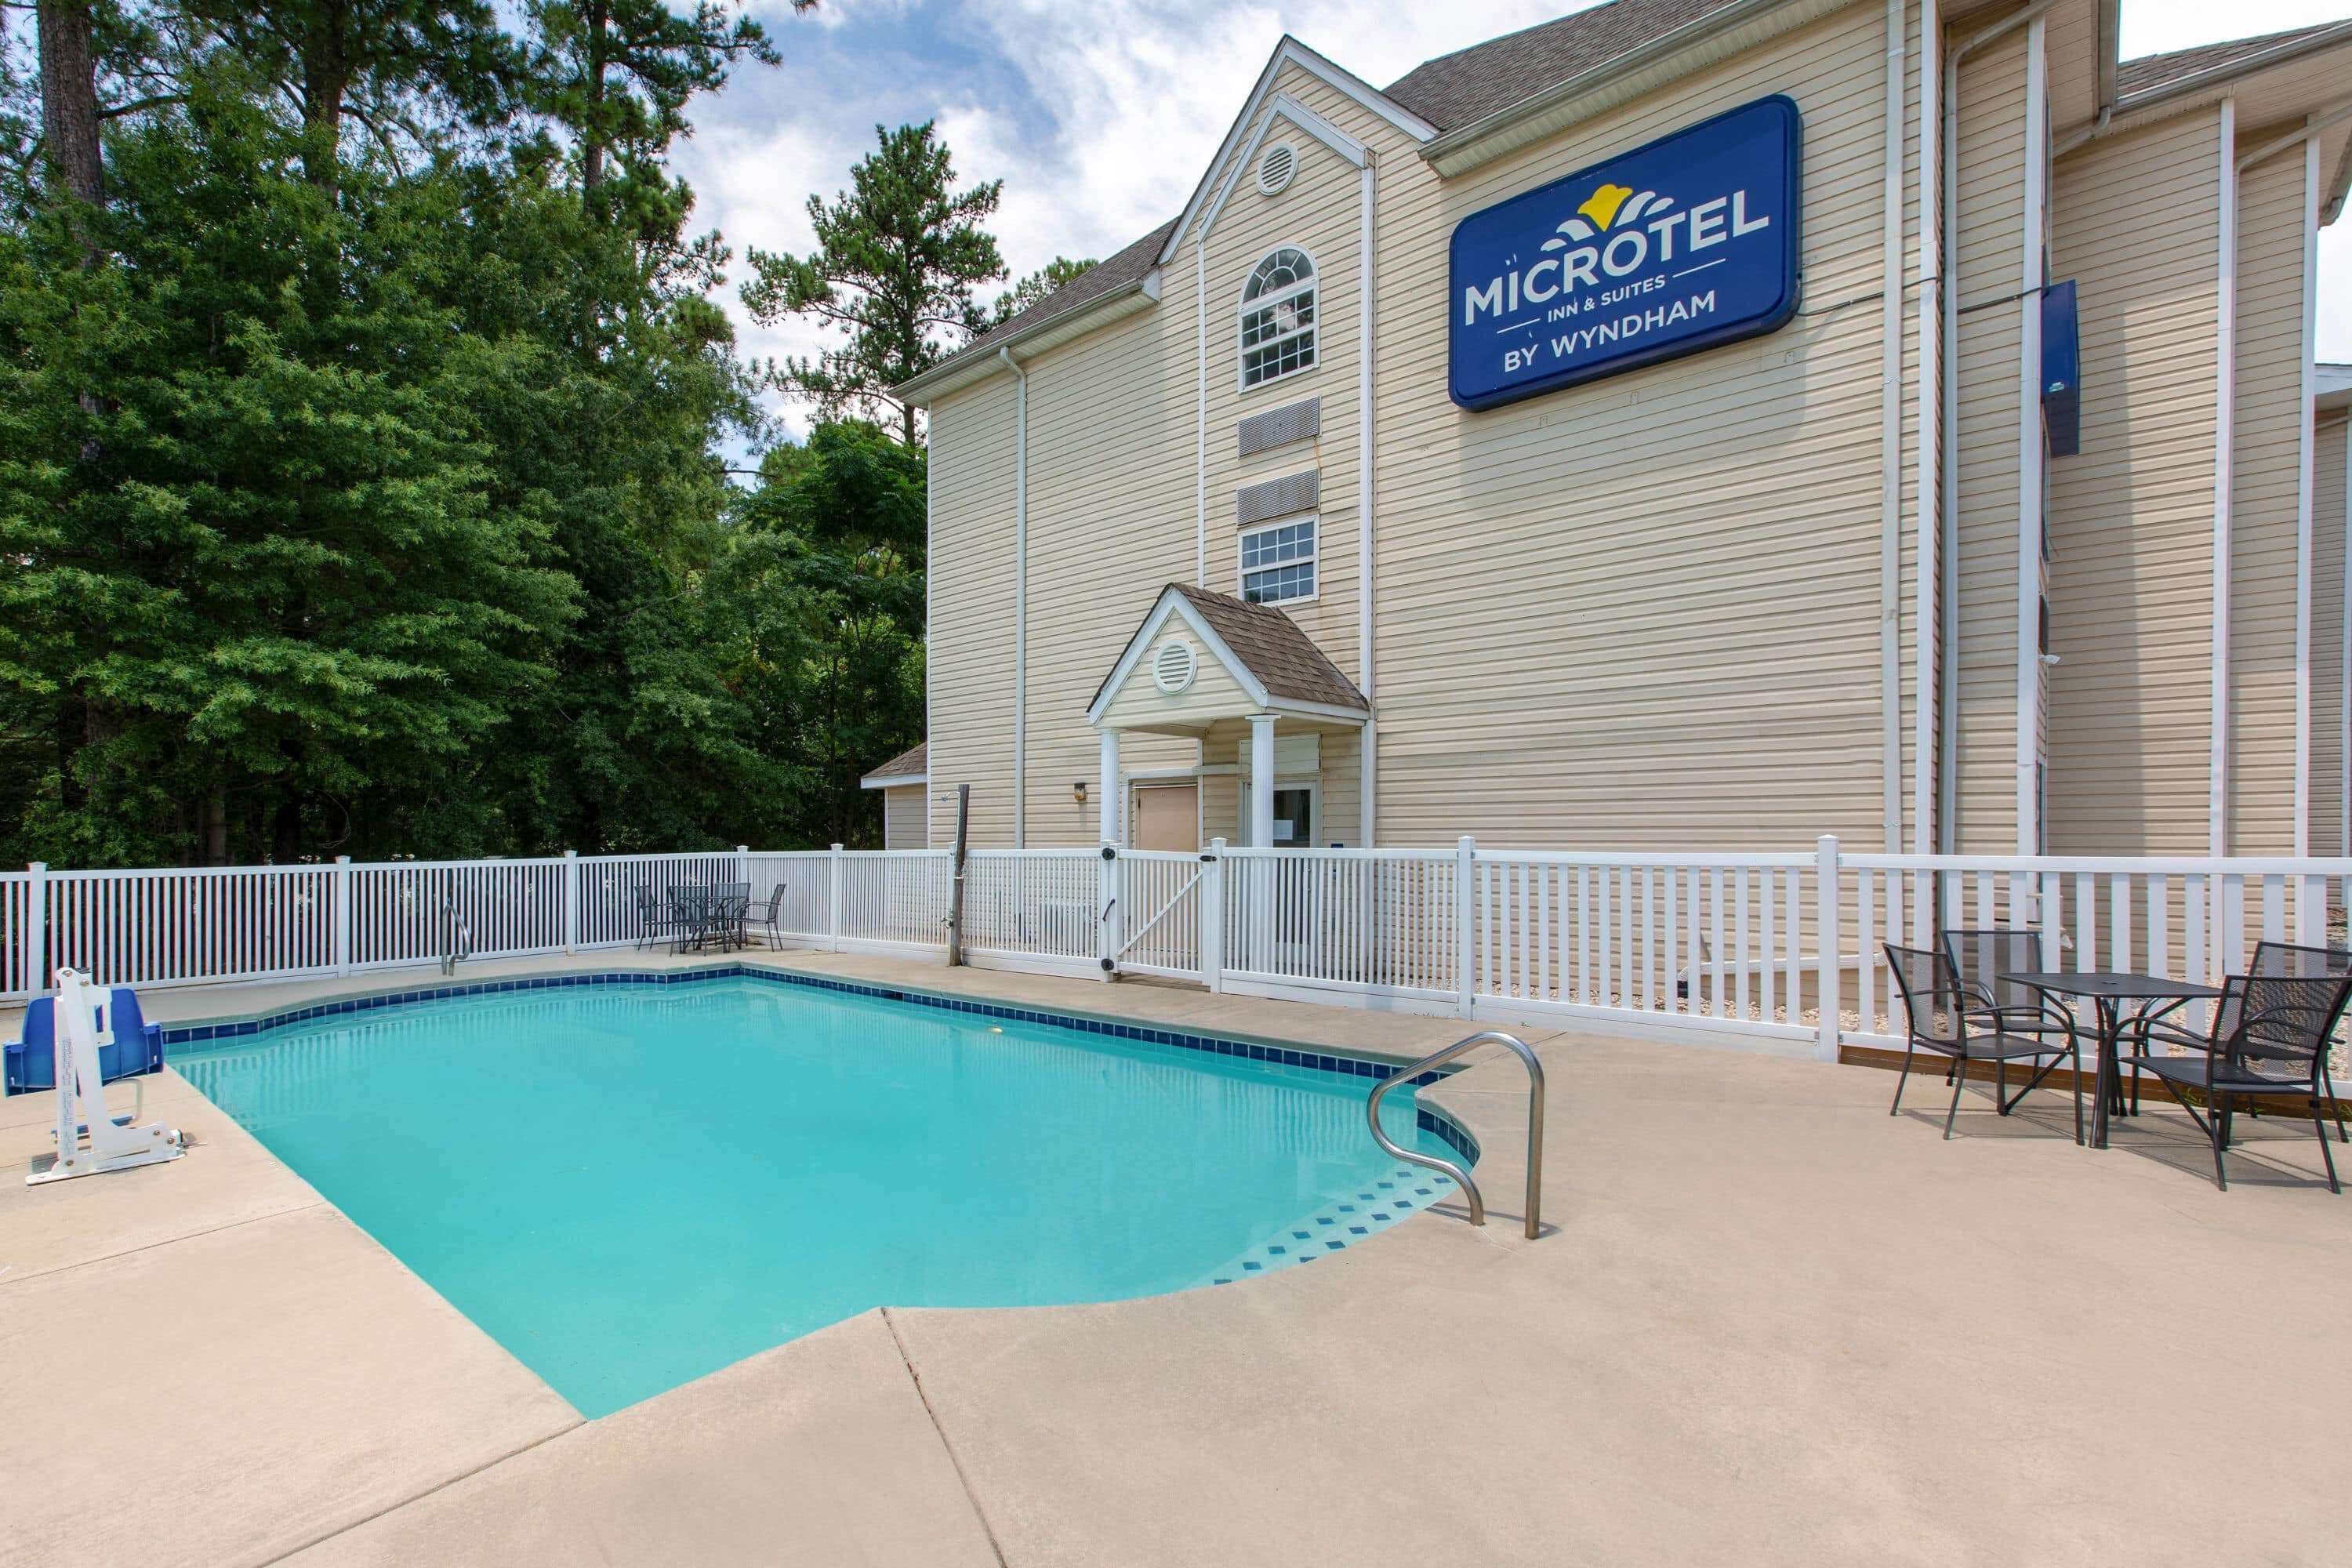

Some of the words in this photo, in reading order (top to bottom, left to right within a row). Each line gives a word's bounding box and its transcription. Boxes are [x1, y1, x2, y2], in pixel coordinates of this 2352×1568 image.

[1465, 190, 1769, 326] MICROTEL
[1548, 300, 1578, 323] INN
[1584, 297, 1595, 311] &
[1600, 274, 1665, 306] SUITES
[1504, 343, 1538, 372] BY
[1551, 289, 1715, 358] WYNDHAM
